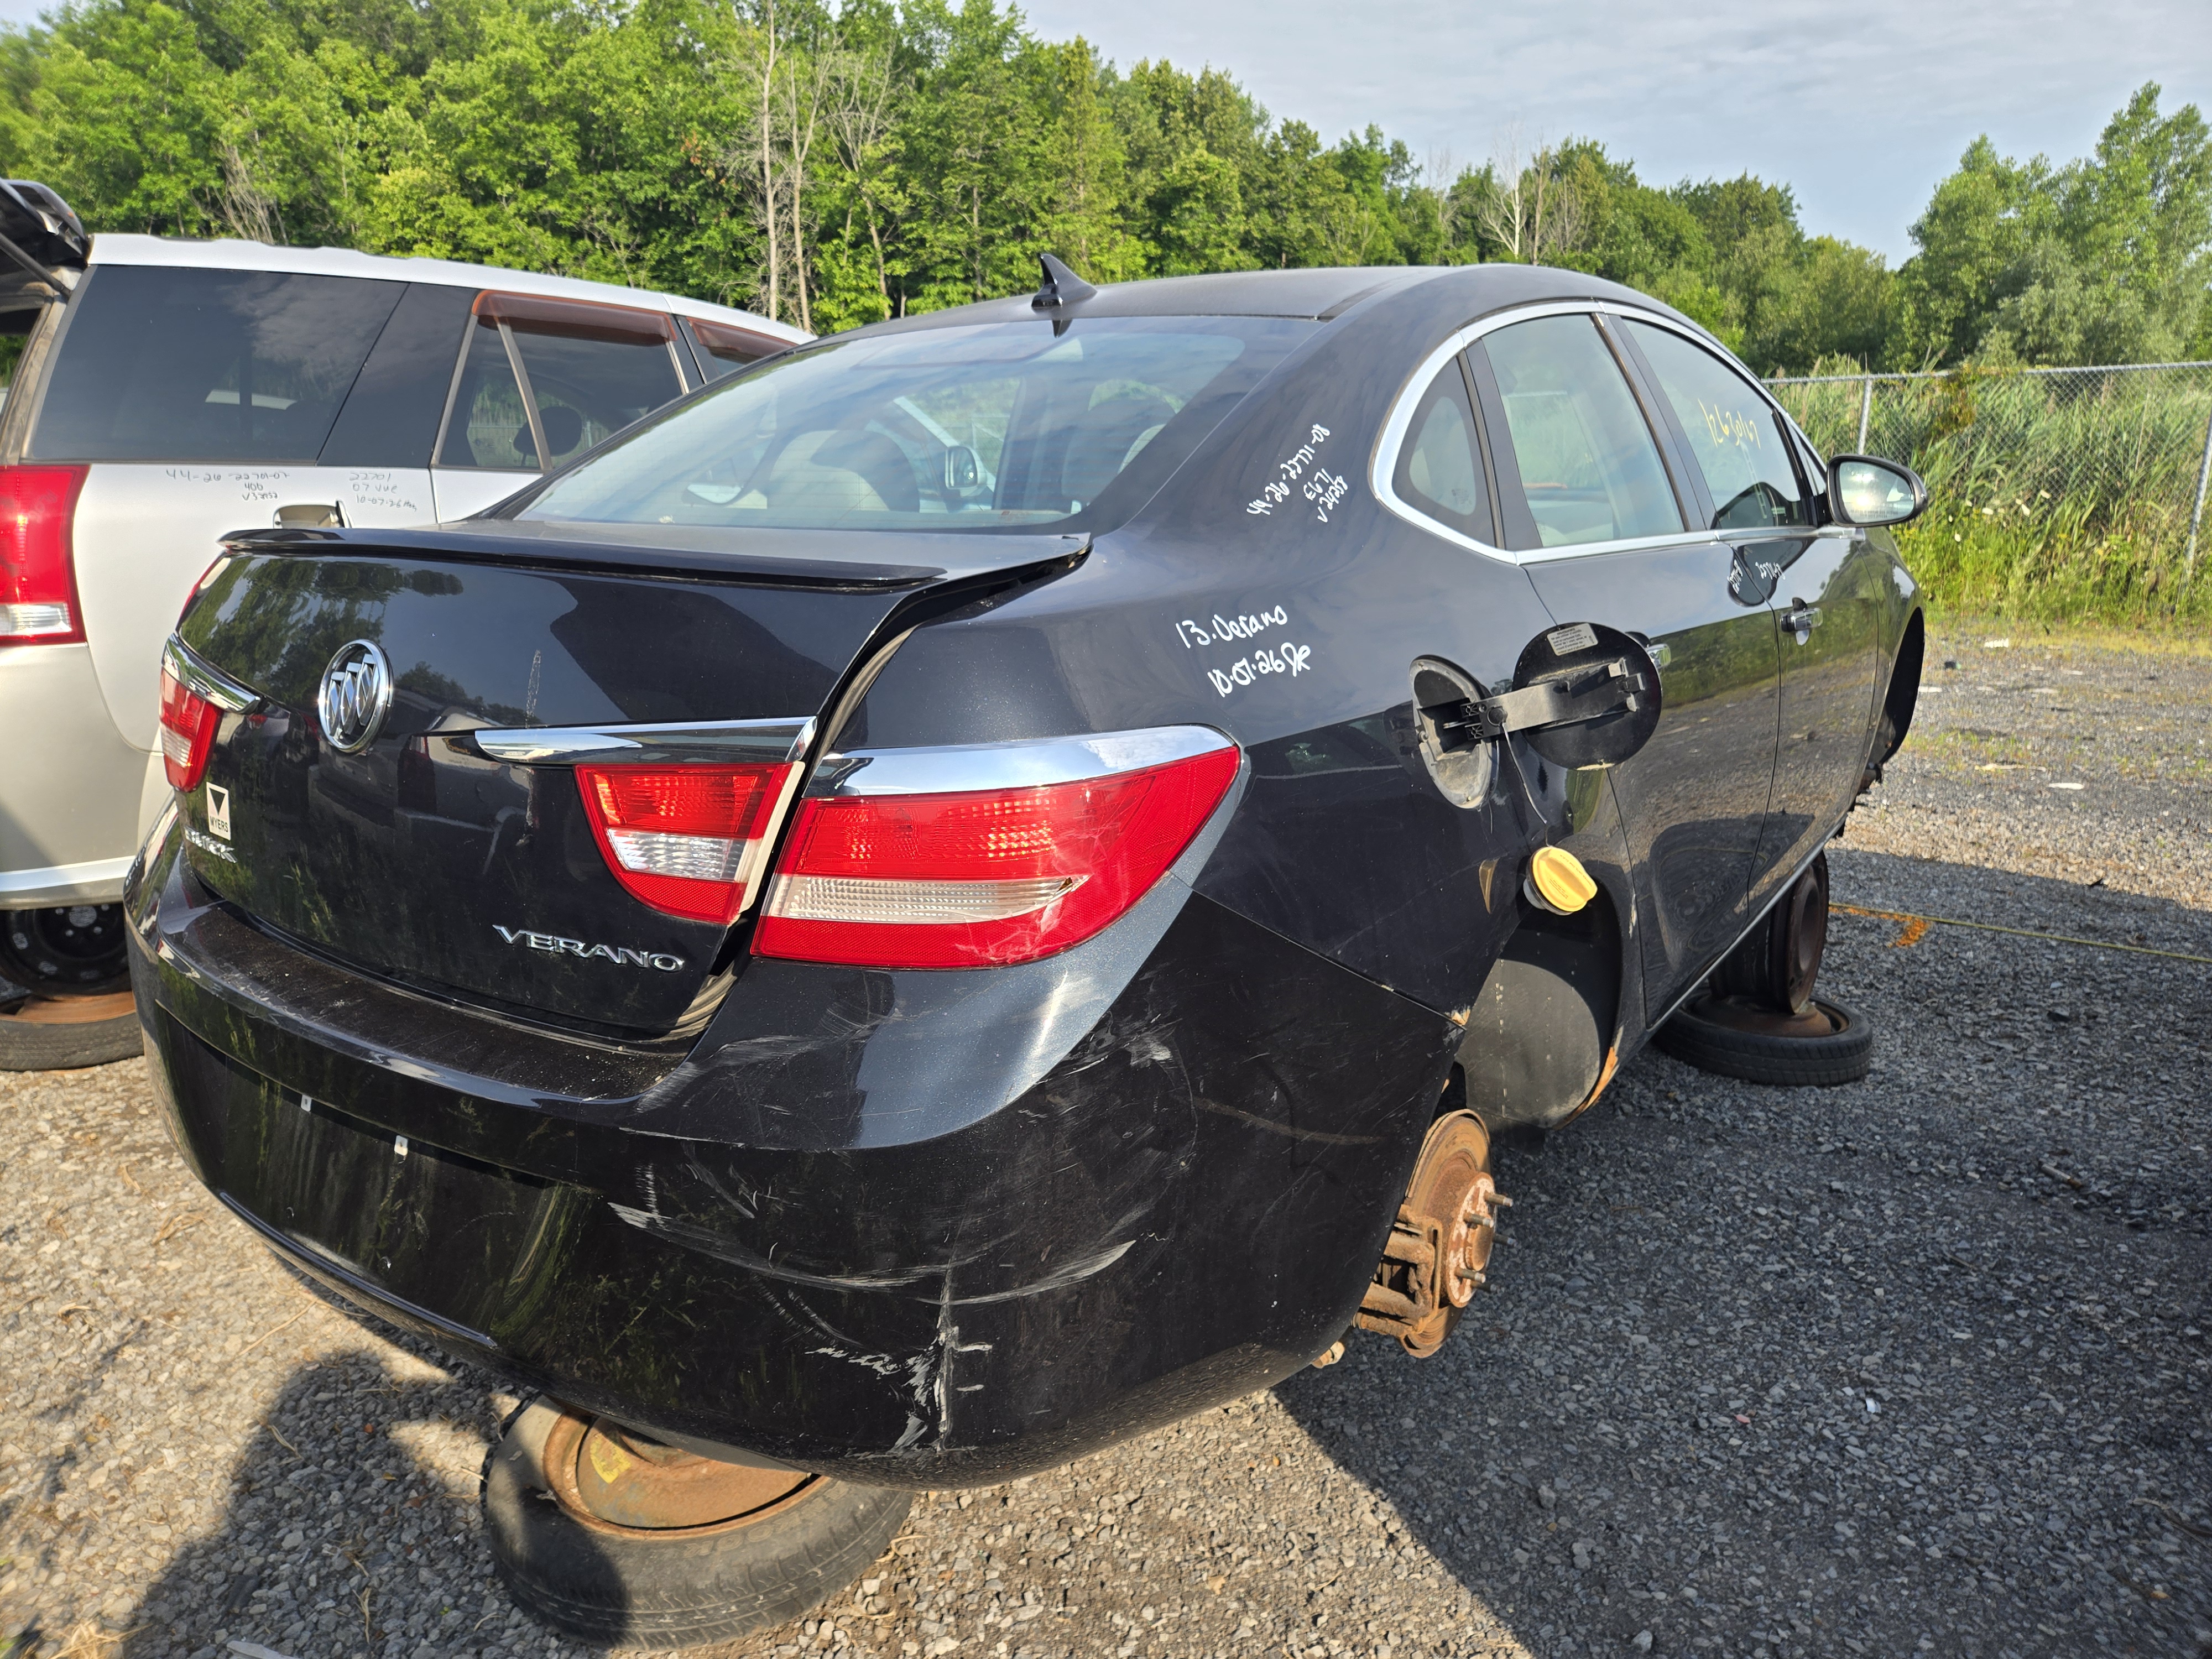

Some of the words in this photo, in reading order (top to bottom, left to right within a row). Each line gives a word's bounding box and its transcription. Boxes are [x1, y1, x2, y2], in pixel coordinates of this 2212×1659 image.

[349, 471, 391, 482] 22701
[352, 482, 370, 492] 07
[210, 816, 228, 832] MYERS
[492, 924, 685, 972] VERANO
[682, 1481, 849, 1557] ANKOOK
